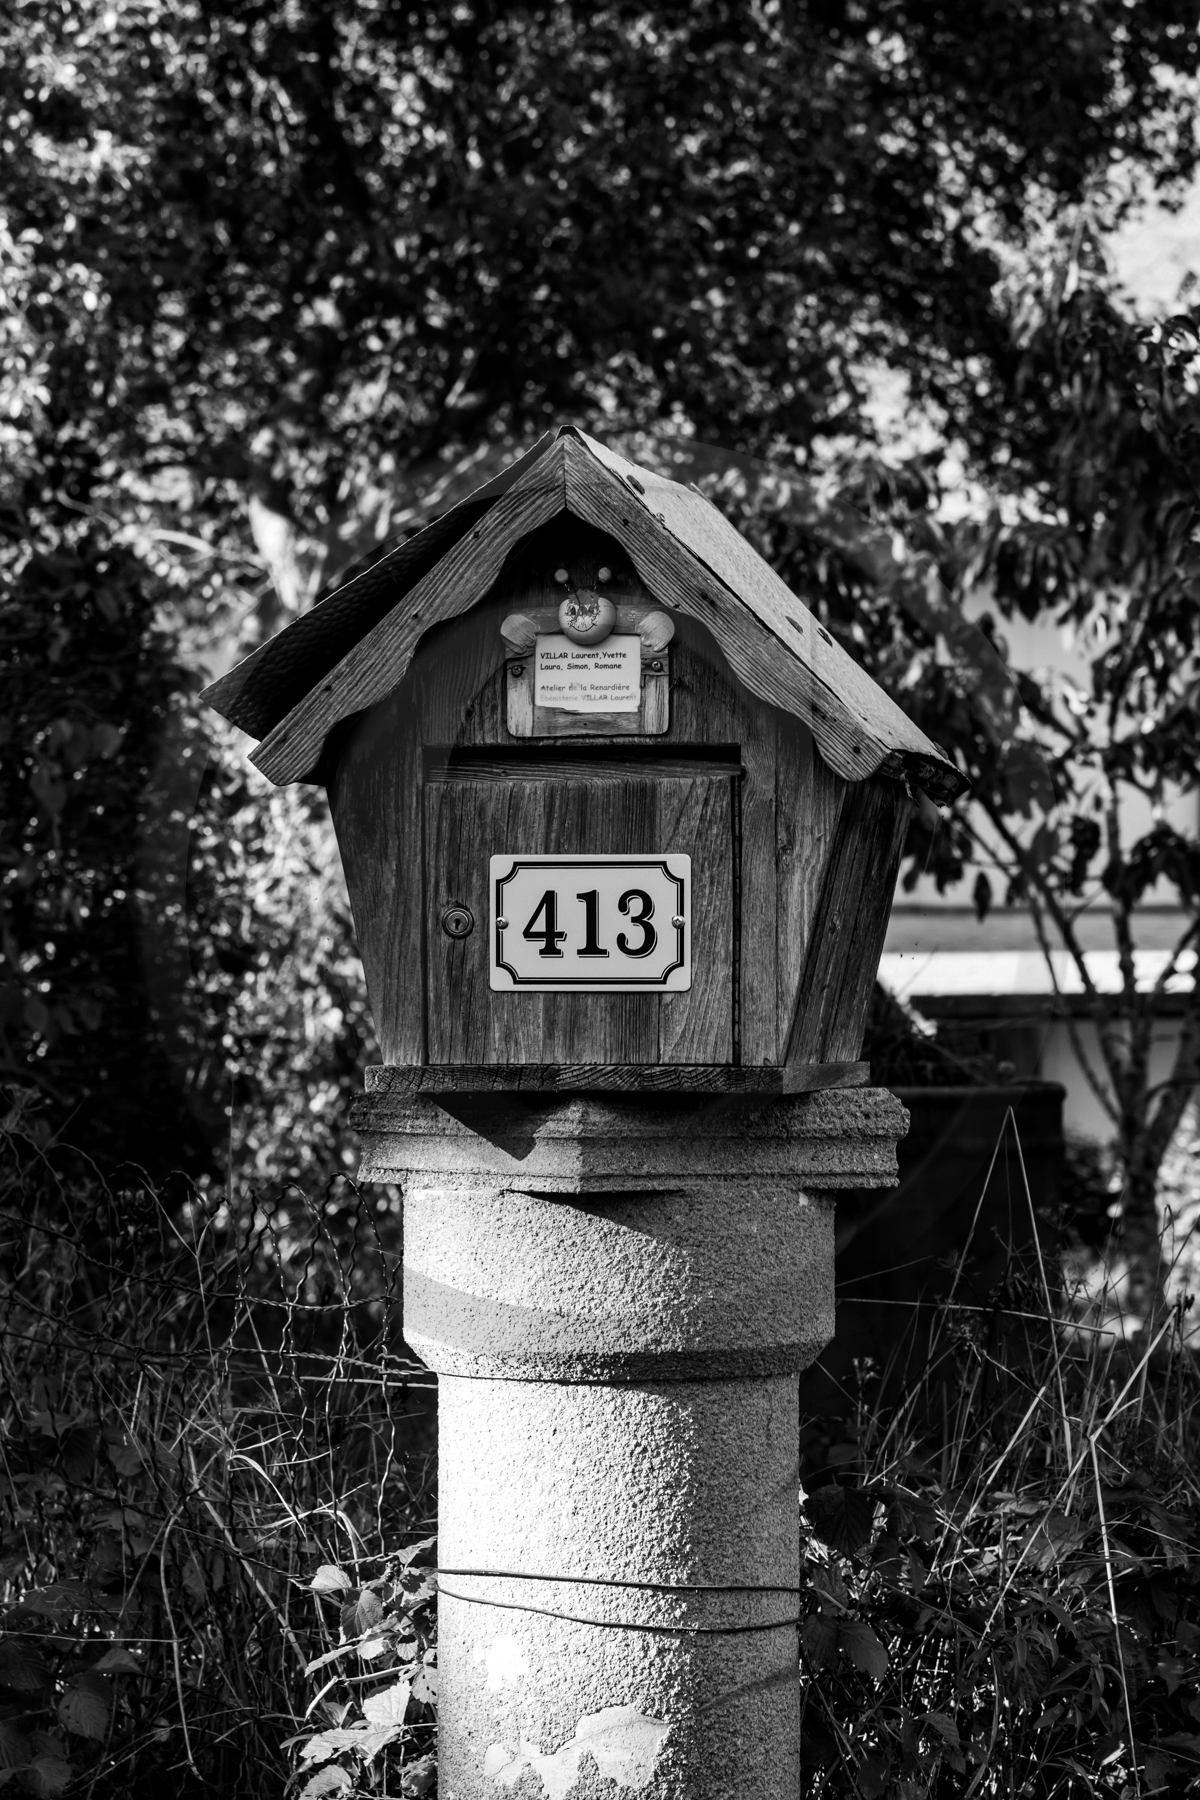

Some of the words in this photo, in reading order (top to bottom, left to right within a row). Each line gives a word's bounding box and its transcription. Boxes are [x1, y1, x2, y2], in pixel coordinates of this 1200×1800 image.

[540, 652, 568, 660] VILLAR
[540, 663, 563, 671] Laura,
[566, 662, 591, 671] Simon,
[594, 662, 622, 670] Romane
[590, 683, 630, 691] Renardière
[522, 888, 658, 959] 413
